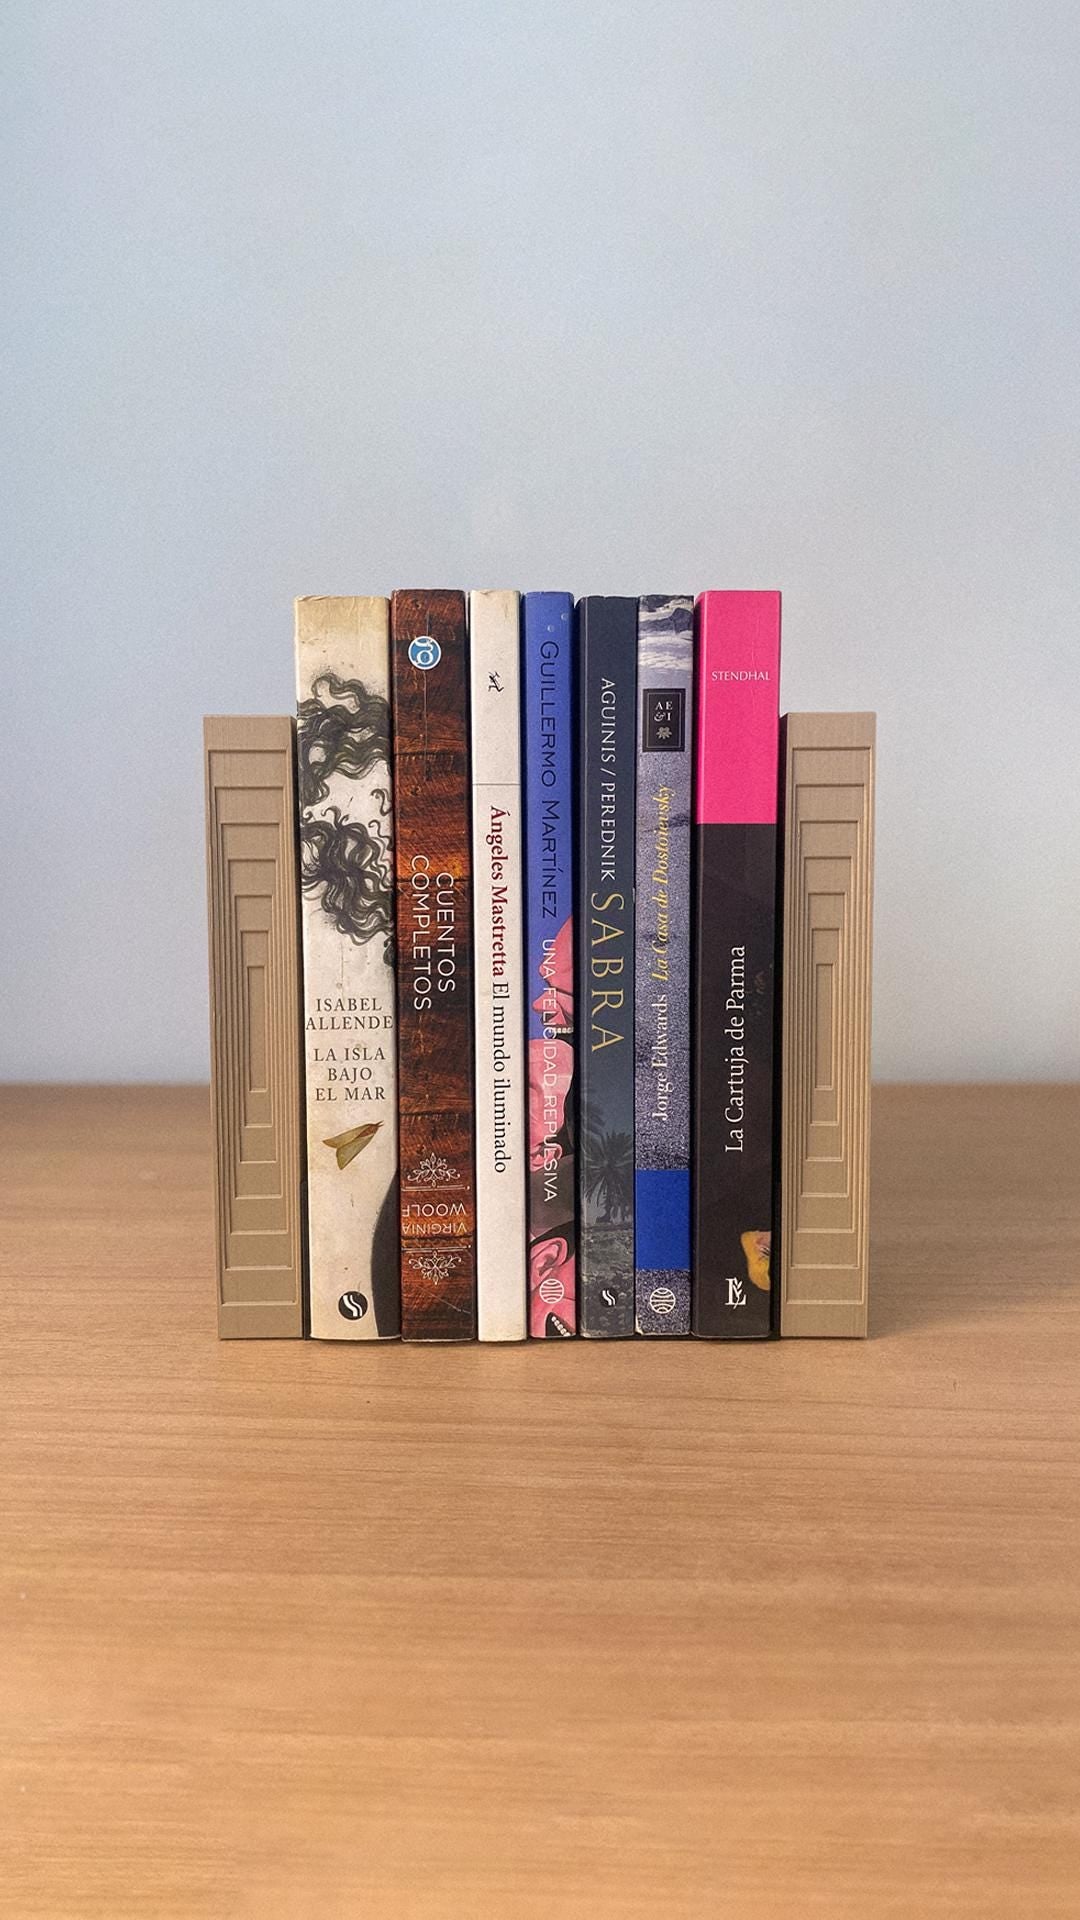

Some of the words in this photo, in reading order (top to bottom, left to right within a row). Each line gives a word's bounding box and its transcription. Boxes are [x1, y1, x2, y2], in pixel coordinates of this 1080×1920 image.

[711, 670, 771, 681] STENDHAL
[540, 640, 560, 787] GUILLERMO
[601, 677, 616, 763] AGUINIS
[486, 805, 509, 880] Ángeles
[542, 800, 562, 919] MARTÍNEZ
[601, 782, 617, 881] PEREDNIK
[652, 783, 677, 884] Dostoievsky
[652, 889, 669, 908] de
[411, 854, 432, 1010] COMPLETOS
[436, 872, 456, 993] CUENTOS
[491, 885, 509, 978] Mastretta
[542, 939, 556, 980] UNA
[651, 913, 669, 954] Casa
[492, 982, 510, 999] El
[591, 892, 625, 1052] SABRA
[651, 958, 669, 982] La
[726, 946, 745, 1010] Parma
[306, 1015, 394, 1030] ALLENDE
[316, 998, 382, 1012] ISABEL
[543, 987, 557, 1087] FELICIDAD
[651, 994, 668, 1068] Edwards
[724, 1016, 745, 1040] de
[314, 1048, 337, 1062] LA
[344, 1047, 386, 1061] ISLA
[492, 1005, 511, 1073] mundo
[316, 1087, 338, 1101] EL
[344, 1086, 386, 1101] MAR
[327, 1067, 372, 1084] BAJO
[652, 1072, 674, 1121] Jorge
[724, 1046, 749, 1123] Cartuja
[493, 1078, 511, 1174] iluminado
[544, 1095, 558, 1203] REPULSIVA
[725, 1128, 744, 1152] La
[401, 1203, 467, 1217] WOOLF
[401, 1222, 468, 1235] VIRGINIA
